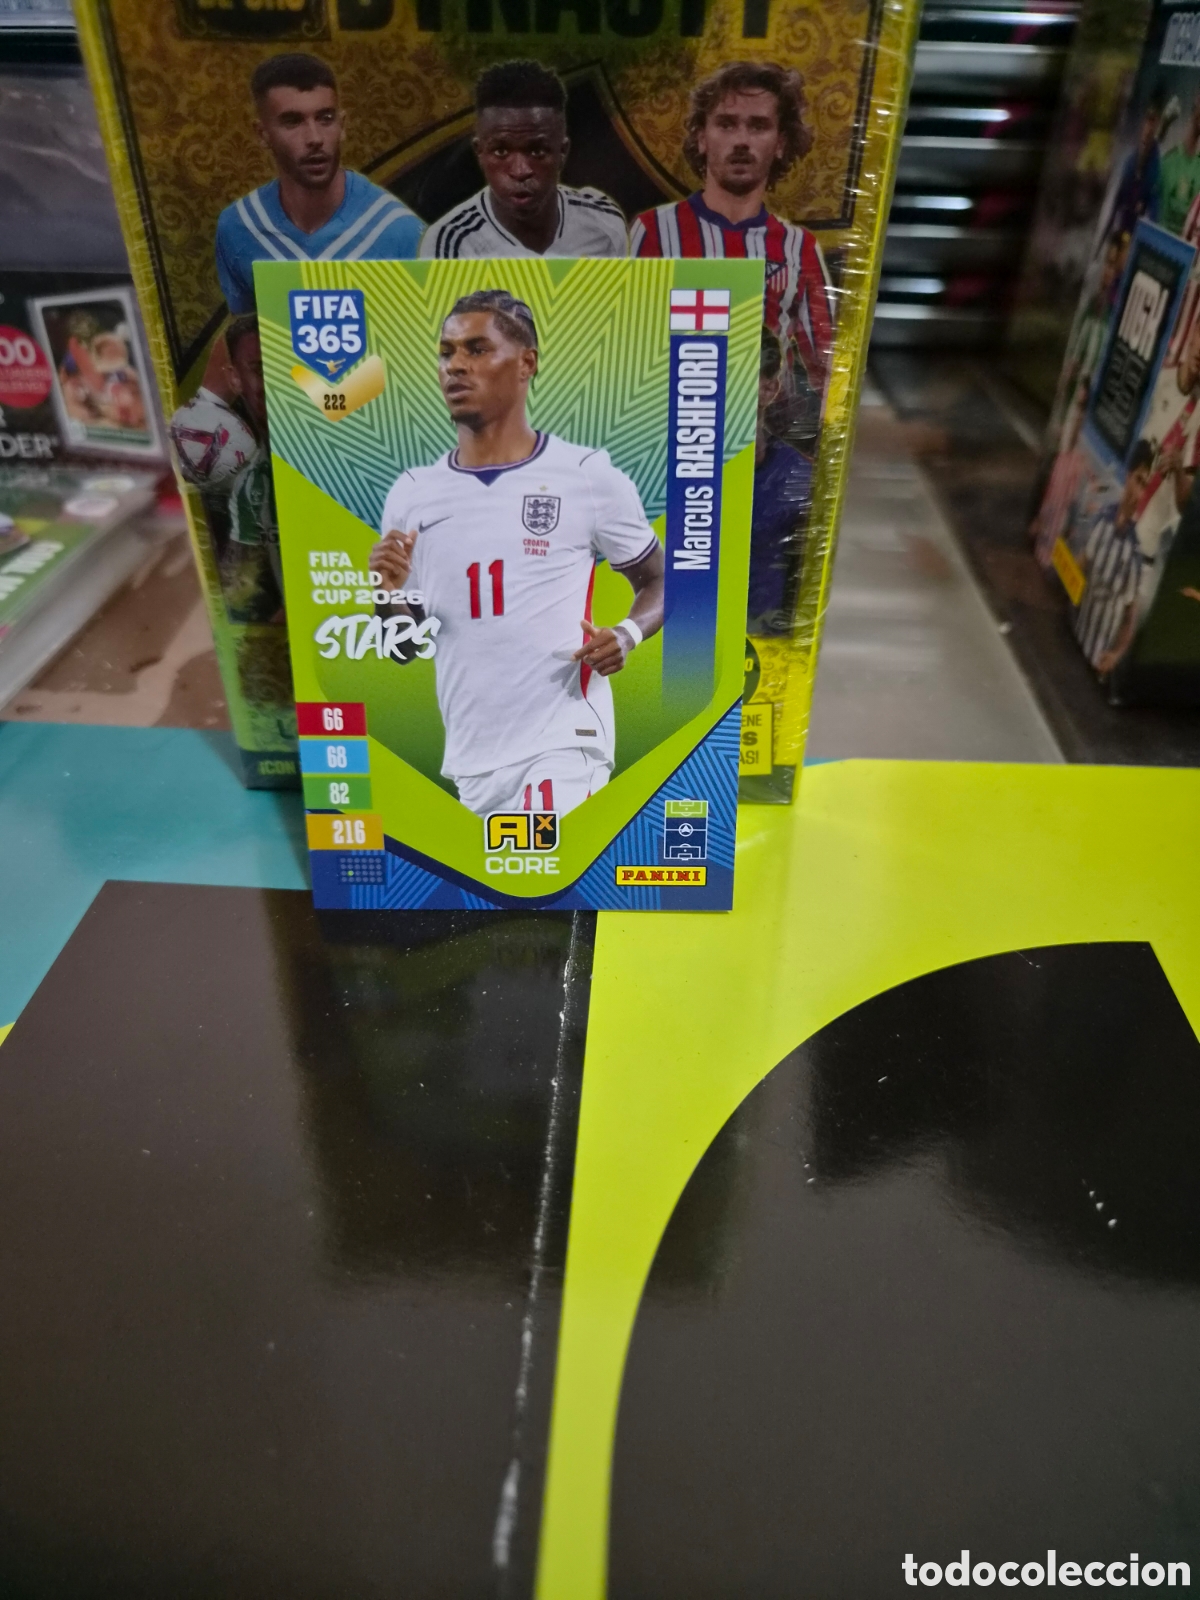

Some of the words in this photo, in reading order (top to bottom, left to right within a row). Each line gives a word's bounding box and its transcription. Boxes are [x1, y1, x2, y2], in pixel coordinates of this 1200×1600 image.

[294, 296, 359, 319] FIFA
[297, 324, 362, 353] 365
[323, 394, 346, 410] 222
[675, 342, 719, 478] RASHFORD
[673, 485, 714, 570] Marcus
[522, 539, 550, 548] CROATIA
[308, 551, 353, 568] FIFA
[310, 570, 383, 586] WORLD
[467, 559, 504, 619] 11
[312, 589, 352, 604] CUP
[355, 589, 425, 605] 2026
[314, 614, 441, 660] STARS
[323, 707, 344, 731] 66
[327, 745, 347, 768] 68
[329, 782, 350, 804] 82
[333, 820, 366, 844] 216
[485, 857, 560, 874] CORE
[621, 869, 701, 881] PANINI
